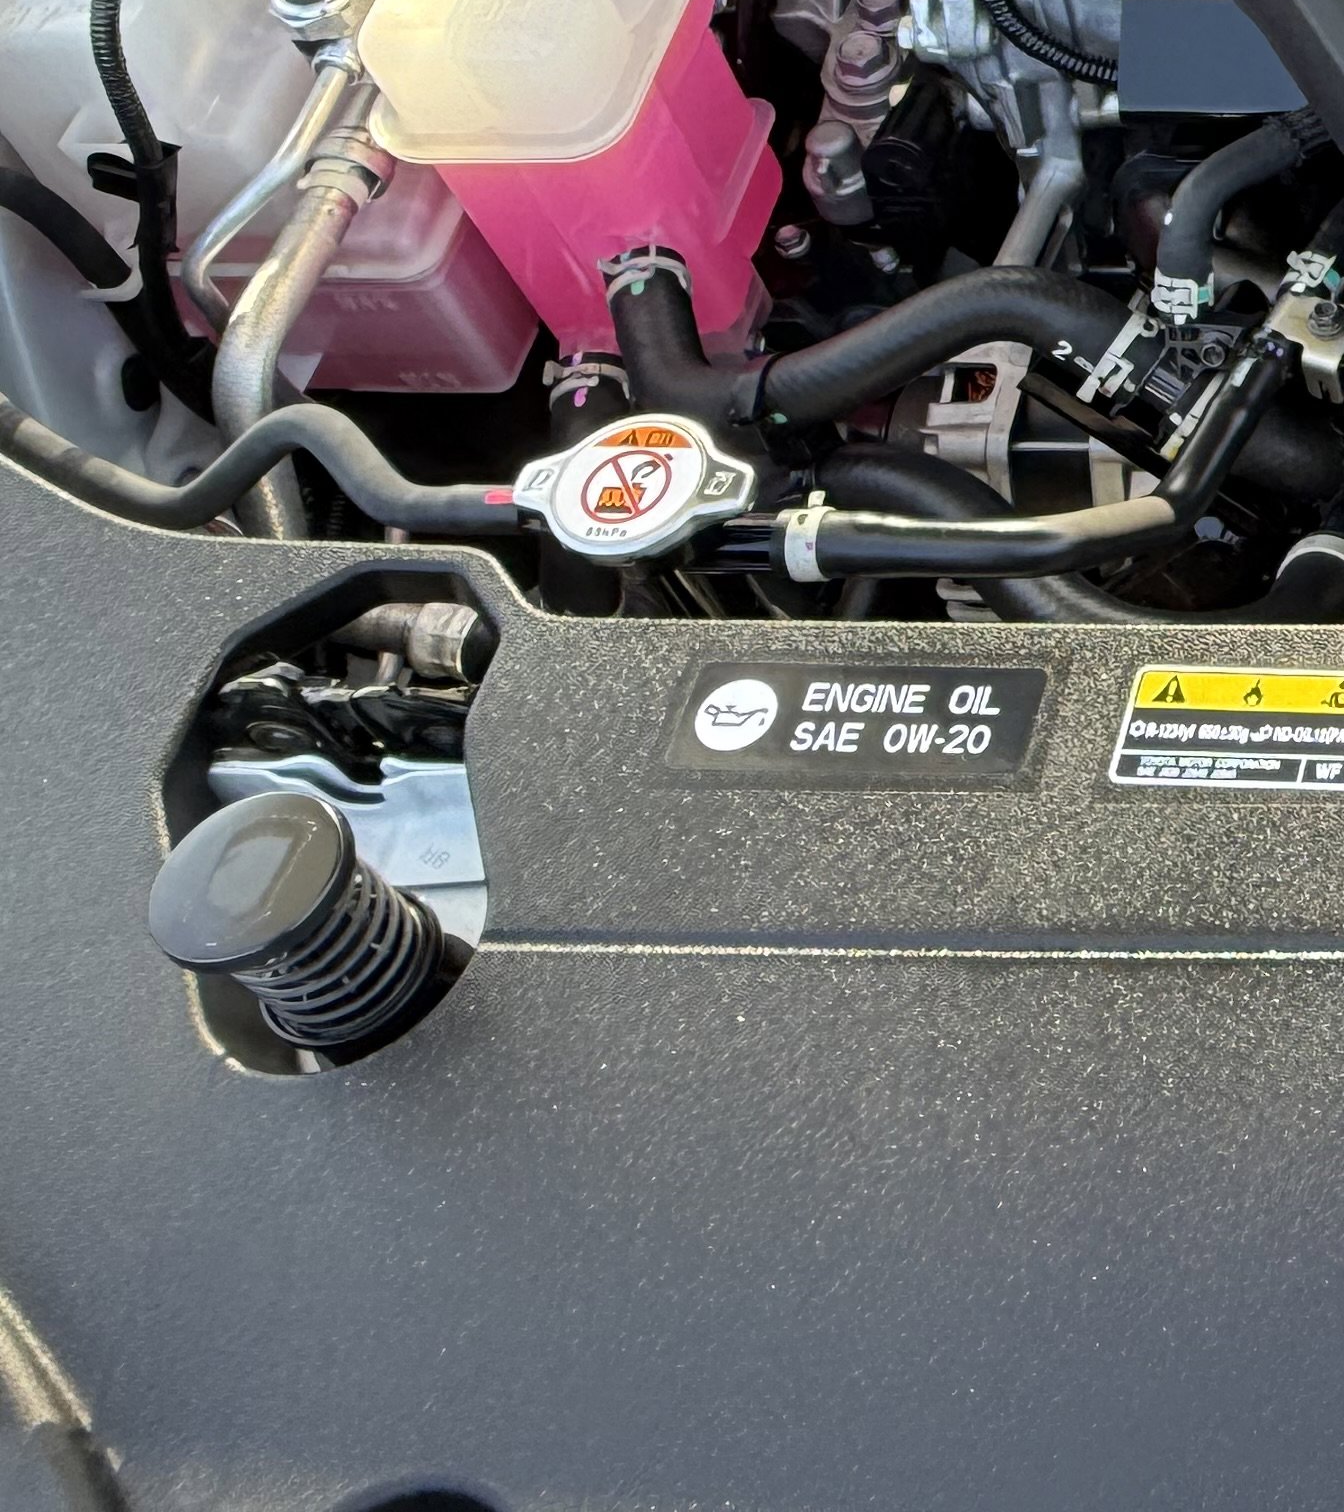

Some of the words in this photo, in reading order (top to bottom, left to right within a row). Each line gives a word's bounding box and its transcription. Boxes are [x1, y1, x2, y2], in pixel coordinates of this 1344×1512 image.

[802, 681, 932, 714] ENGINE
[948, 684, 1001, 717] OIL
[789, 719, 860, 753] SAE
[882, 722, 992, 755] 0W-20
